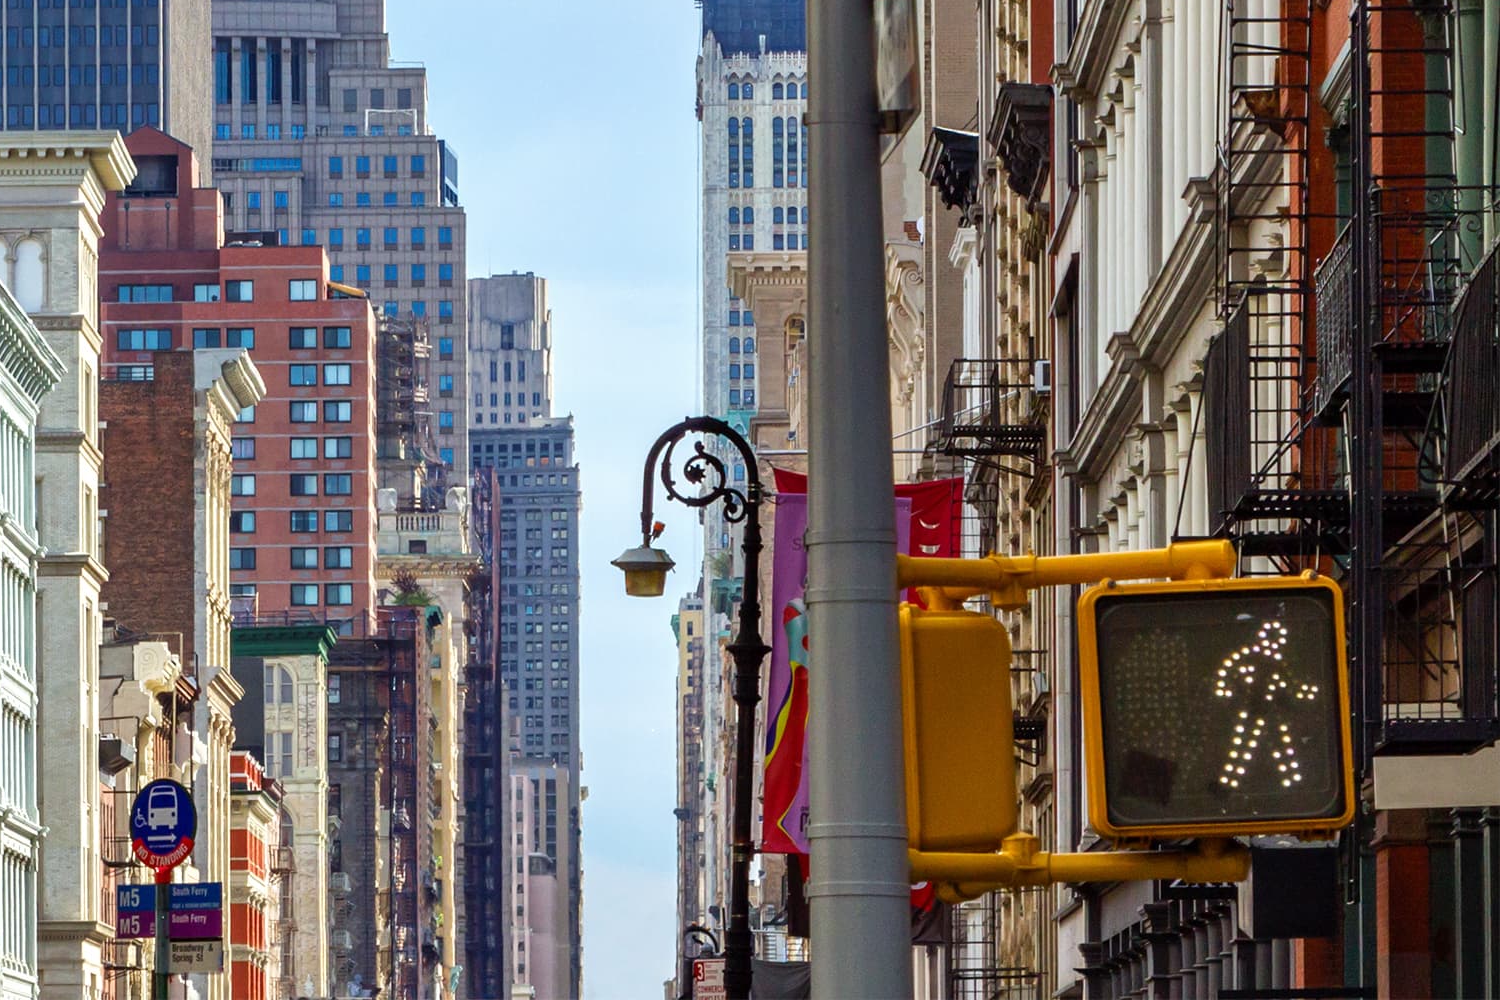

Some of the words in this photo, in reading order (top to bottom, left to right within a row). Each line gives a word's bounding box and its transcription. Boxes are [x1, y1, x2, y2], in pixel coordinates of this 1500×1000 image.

[136, 845, 149, 860] NO
[150, 843, 188, 866] STANDING
[120, 888, 140, 908] M5
[172, 887, 190, 897] South
[191, 887, 208, 897] Ferry
[120, 915, 140, 935] M5
[171, 914, 189, 924] South
[190, 914, 207, 925] Ferry
[172, 943, 204, 955] Broadway
[172, 953, 193, 965] Spring
[196, 953, 204, 962] St
[697, 963, 704, 981] 3
